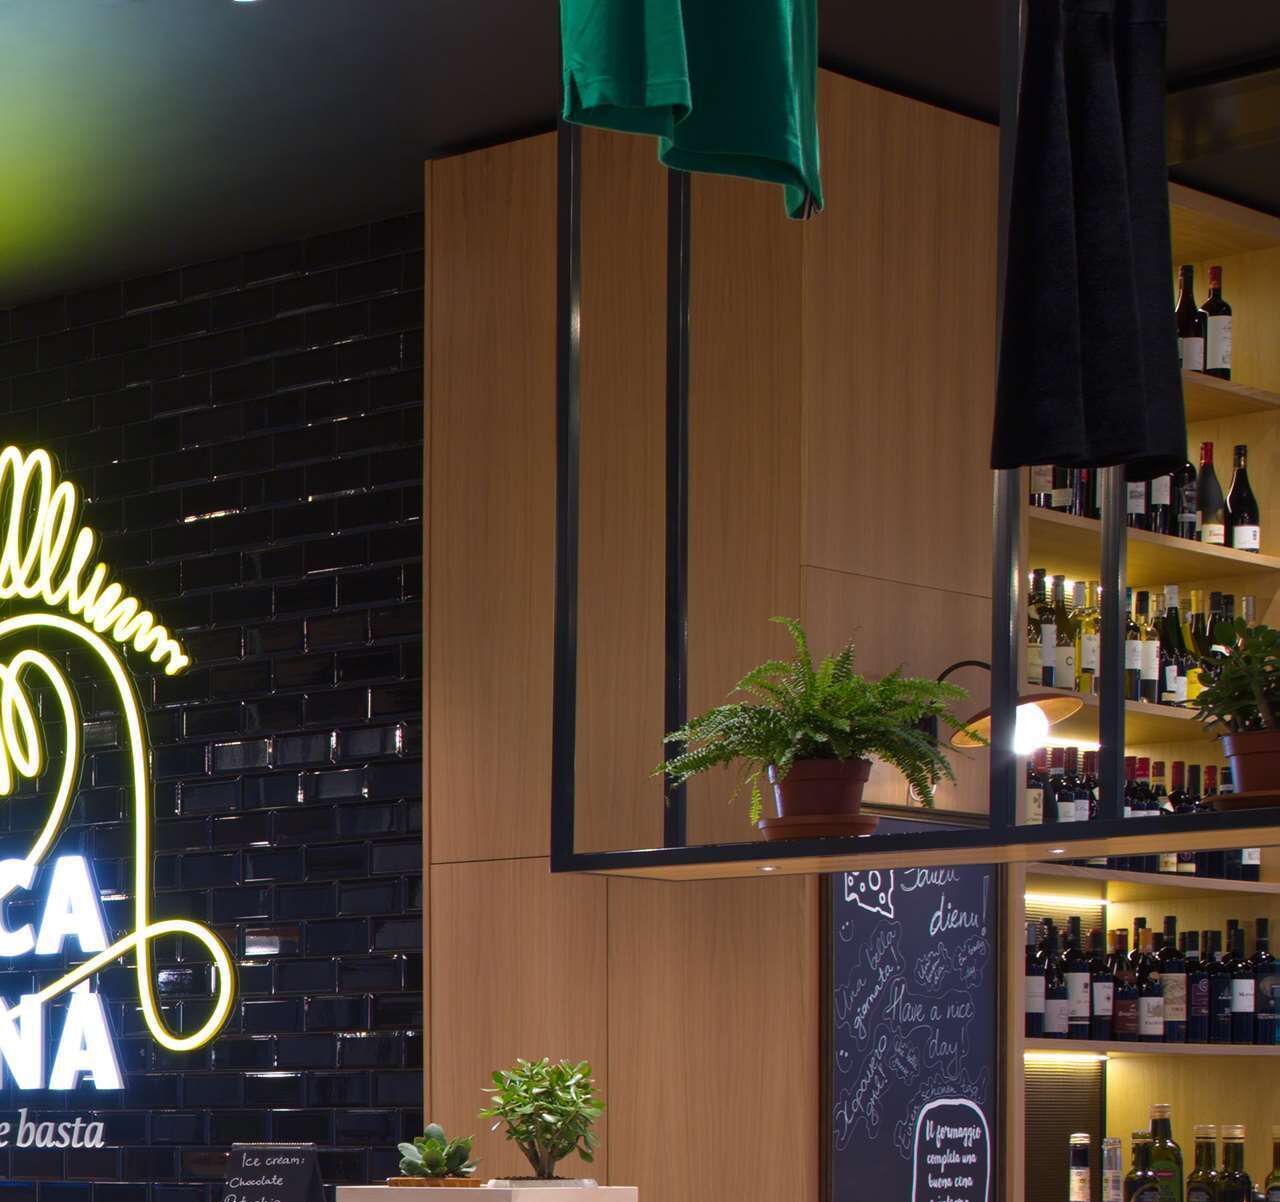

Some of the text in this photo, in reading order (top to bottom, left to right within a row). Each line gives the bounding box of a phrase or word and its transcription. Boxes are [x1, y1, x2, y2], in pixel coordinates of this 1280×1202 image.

[886, 983, 973, 1023] Have a nice
[929, 1027, 967, 1080] day!
[15, 1108, 104, 1149] basta
[925, 1120, 982, 1149] Il formaggio
[242, 1152, 305, 1168] Ice cream:
[961, 1153, 977, 1164] una
[229, 1174, 284, 1188] Chocolate
[928, 1173, 974, 1188] buona cena
